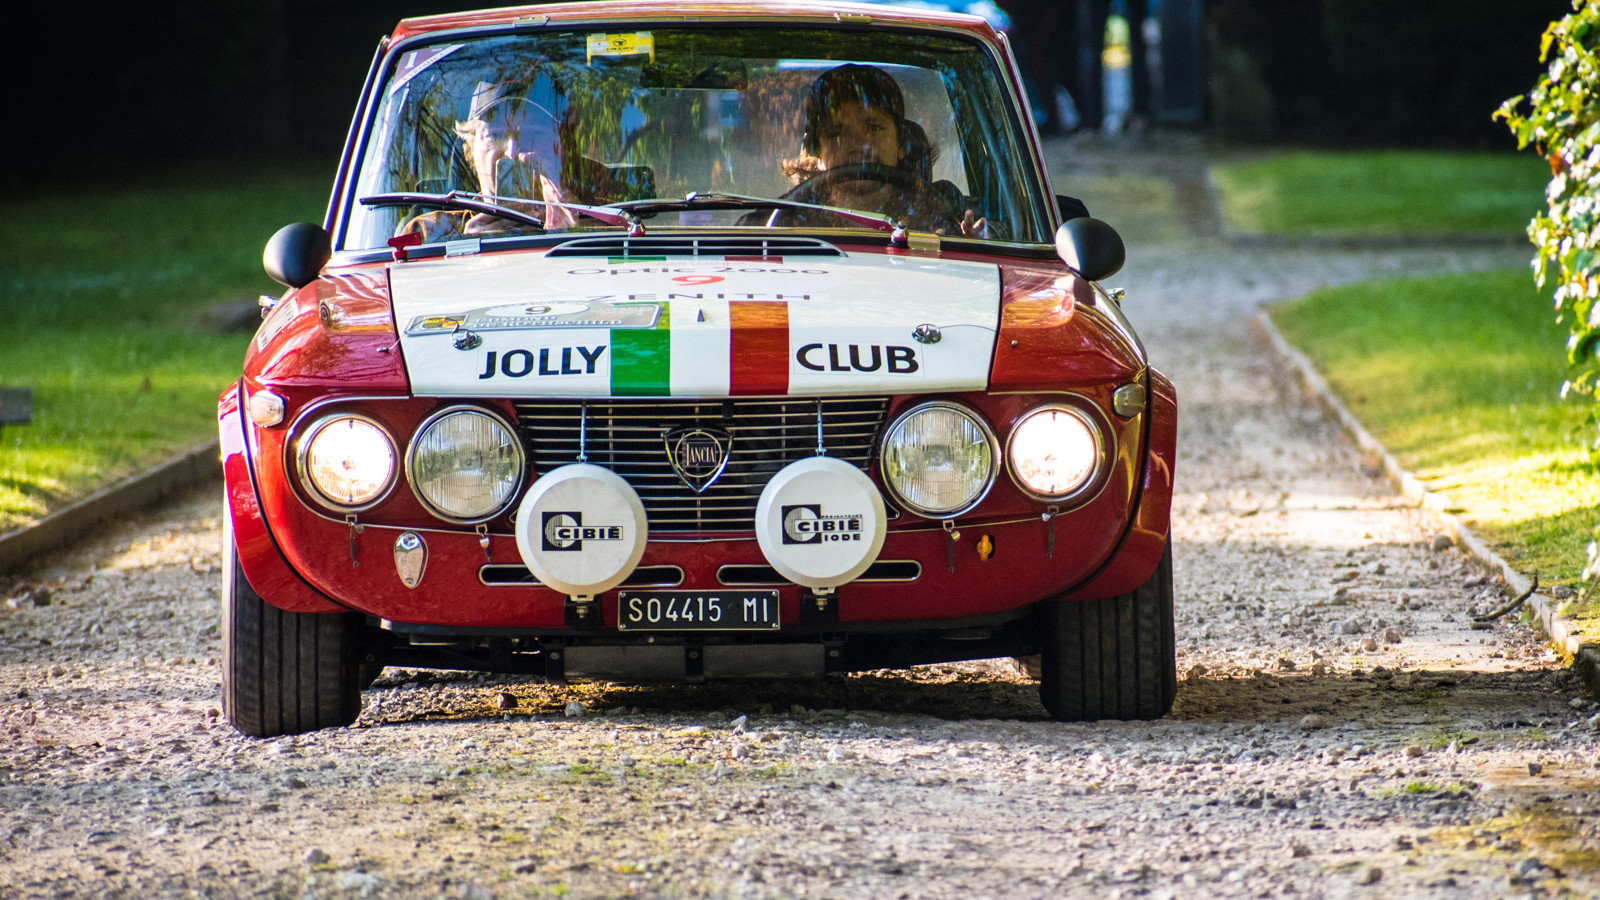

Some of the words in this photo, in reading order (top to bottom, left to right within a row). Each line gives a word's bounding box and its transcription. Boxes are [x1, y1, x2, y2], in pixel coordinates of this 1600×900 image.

[566, 267, 695, 275] Optic
[712, 266, 829, 275] 2000
[671, 275, 726, 286] 9
[585, 293, 811, 301] ZENITH
[524, 305, 552, 315] 9
[479, 344, 607, 379] JOLLY
[796, 343, 919, 374] CLUB
[686, 443, 715, 466] LANCIA
[824, 533, 861, 542] IODE
[743, 597, 768, 623] MI
